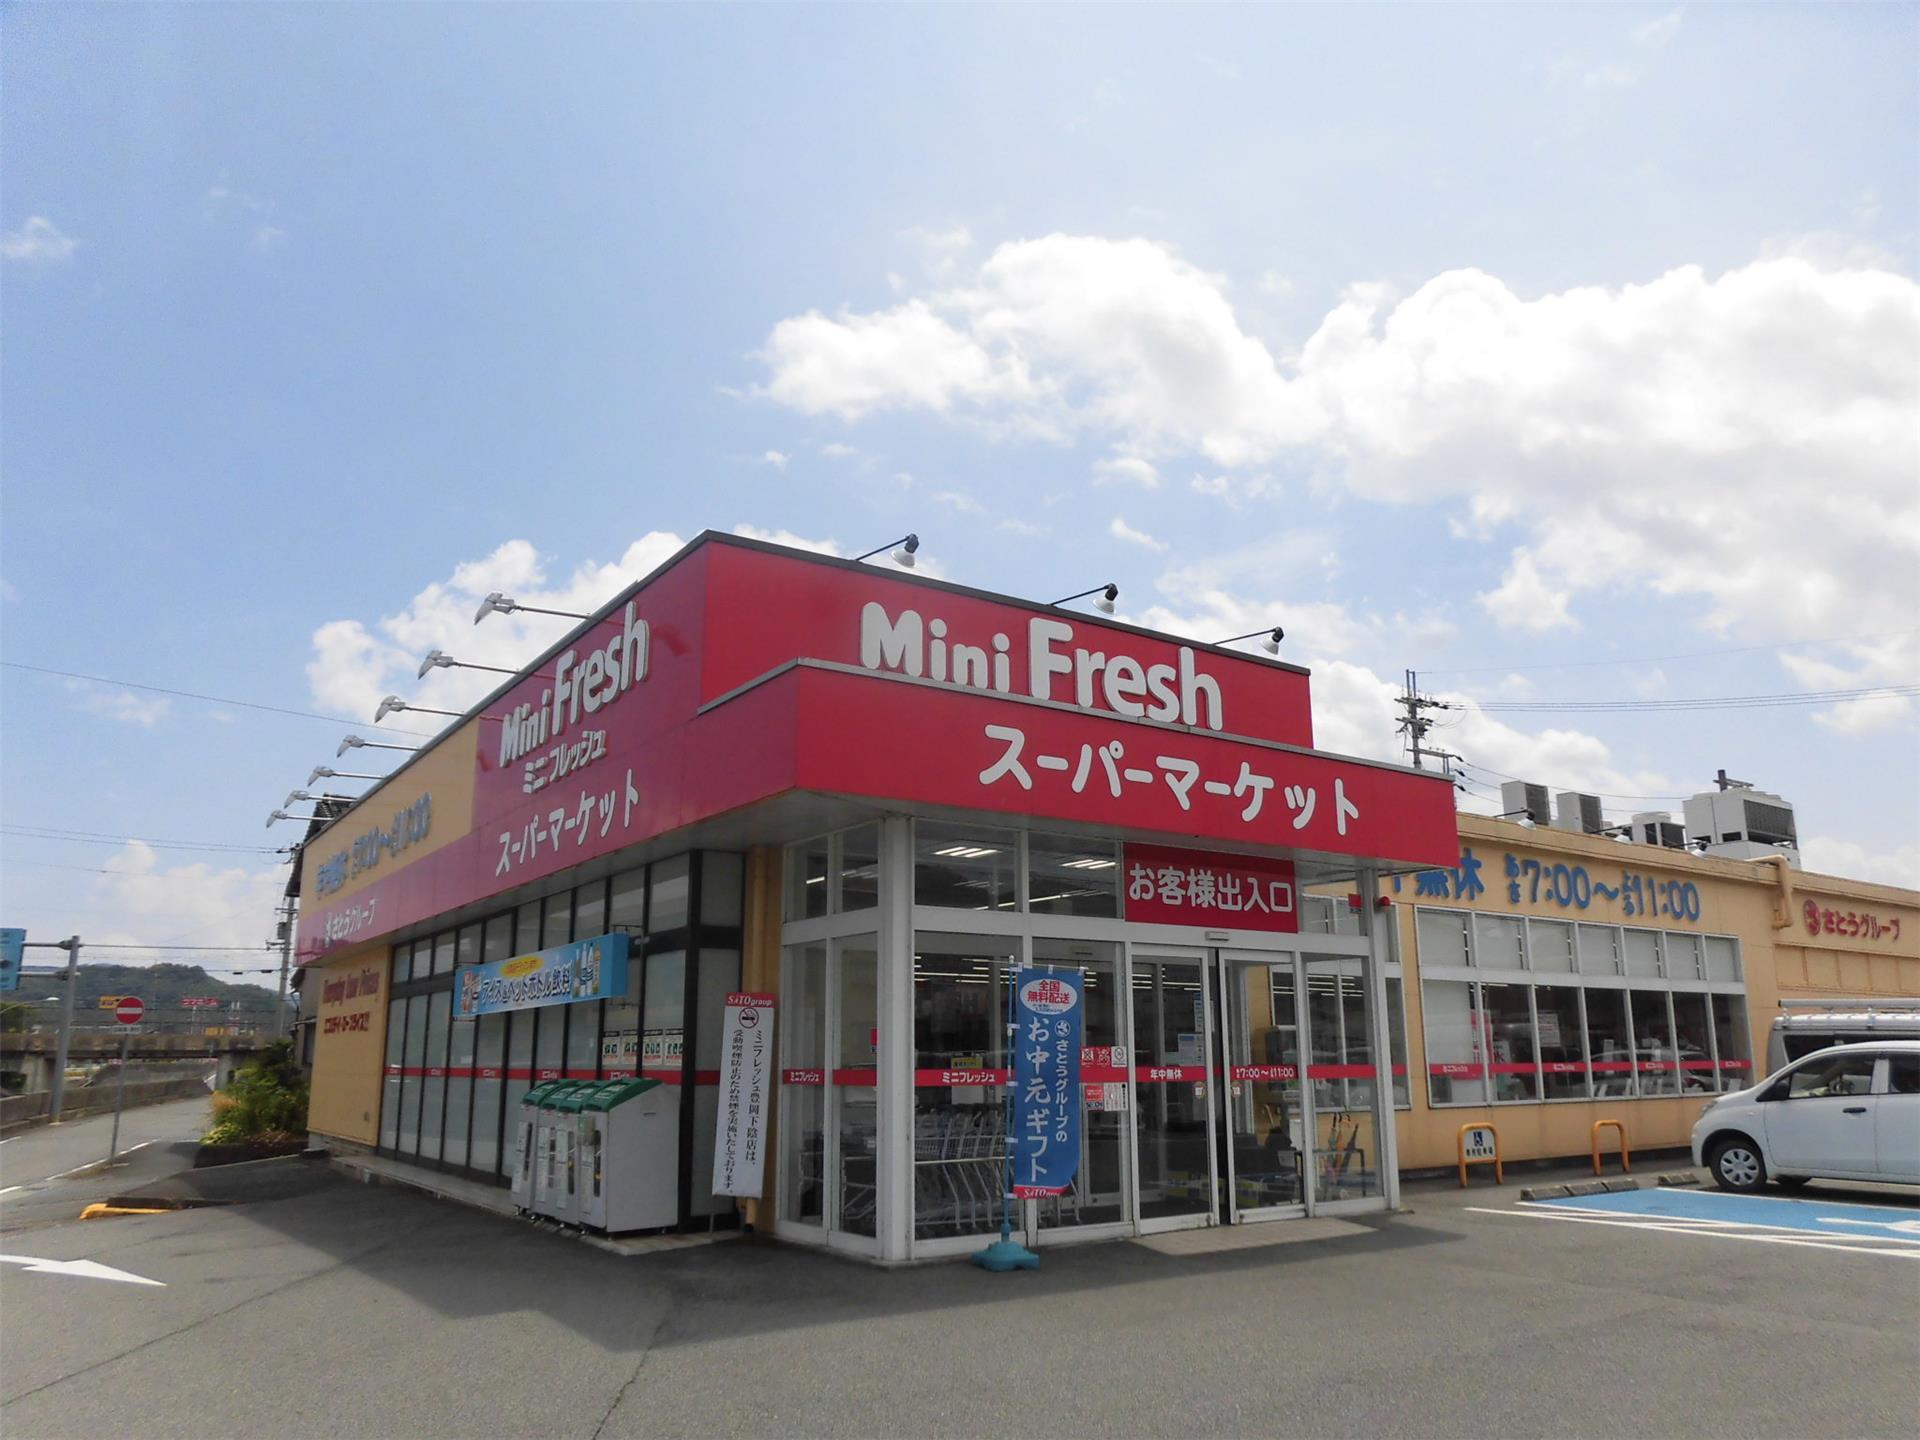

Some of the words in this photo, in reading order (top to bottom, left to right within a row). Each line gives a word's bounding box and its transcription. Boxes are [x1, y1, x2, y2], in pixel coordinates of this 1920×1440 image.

[499, 688, 551, 768] Mini
[552, 600, 650, 735] Fresh
[860, 602, 1010, 694] Mini
[1028, 617, 1223, 731] Fresh
[523, 729, 607, 794] ミニフレッシュ
[979, 724, 1359, 836] スーパーマーケット
[495, 768, 640, 878] スーパーマーケット
[1129, 863, 1293, 913] お客様出入口
[1027, 991, 1070, 1004] 無料配送
[1039, 980, 1060, 992] 全国
[942, 1071, 996, 1083] ミニフレッシュ
[1024, 1016, 1050, 1183] お中元ギフト
[1055, 1039, 1069, 1143] さとうグループの
